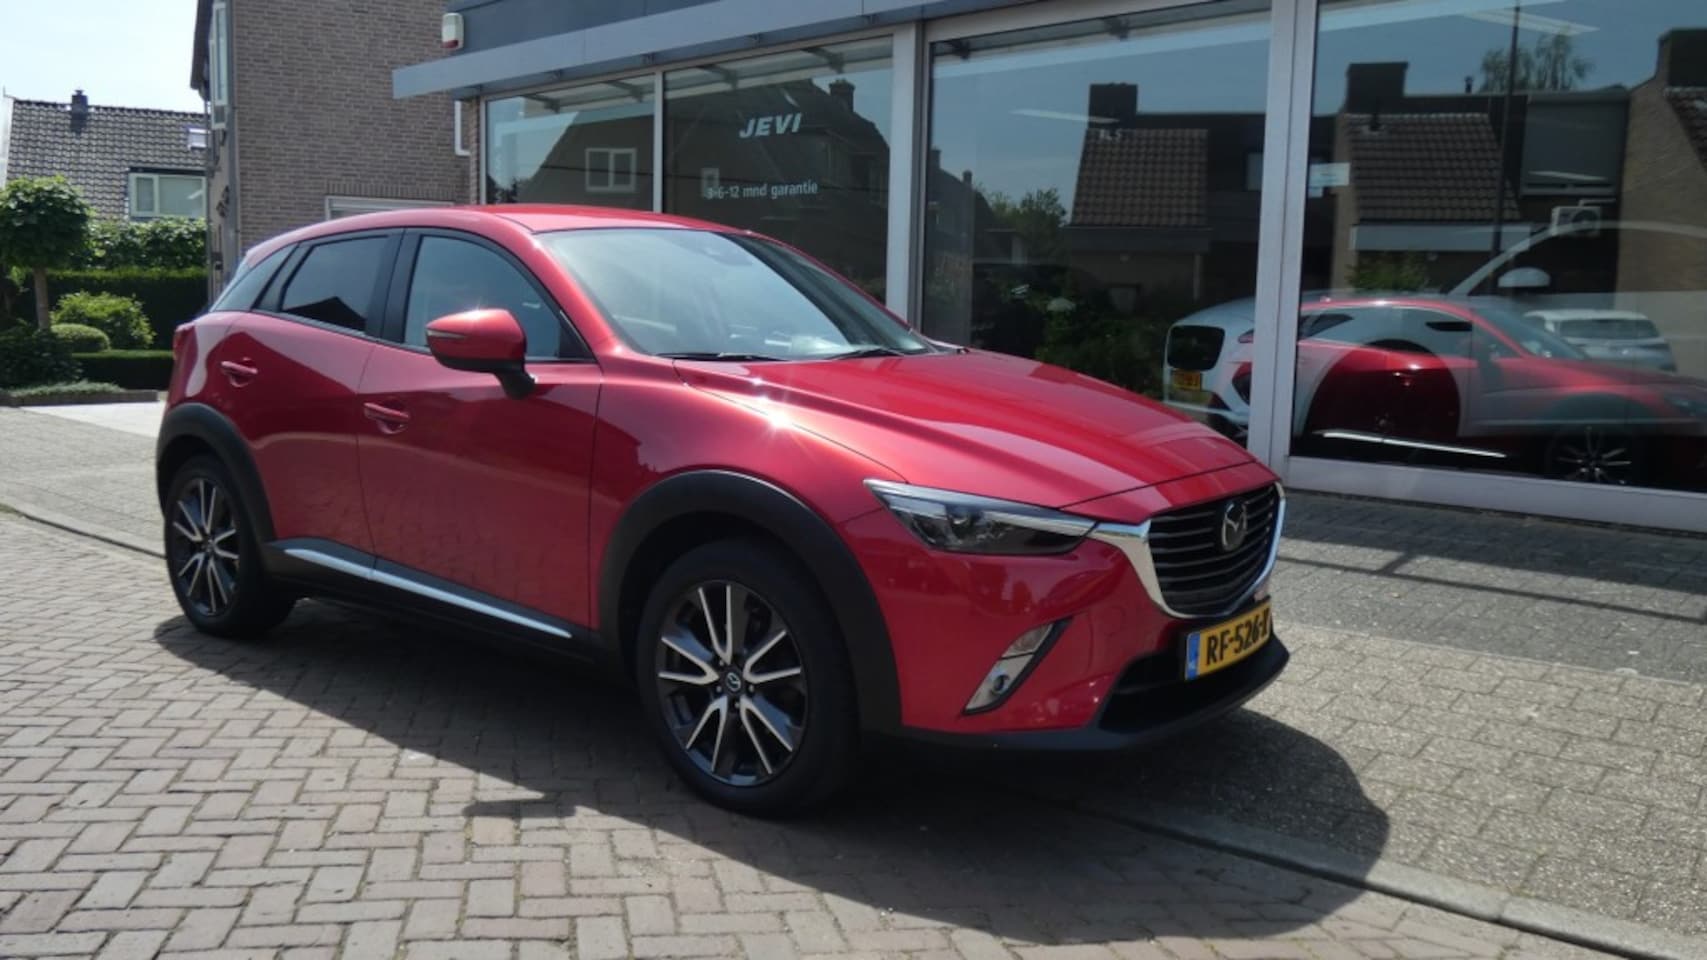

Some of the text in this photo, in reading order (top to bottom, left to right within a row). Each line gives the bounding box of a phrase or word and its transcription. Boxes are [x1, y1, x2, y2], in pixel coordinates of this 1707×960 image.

[739, 113, 802, 138] JEVI
[742, 183, 767, 197] mnd
[771, 179, 818, 199] garantie
